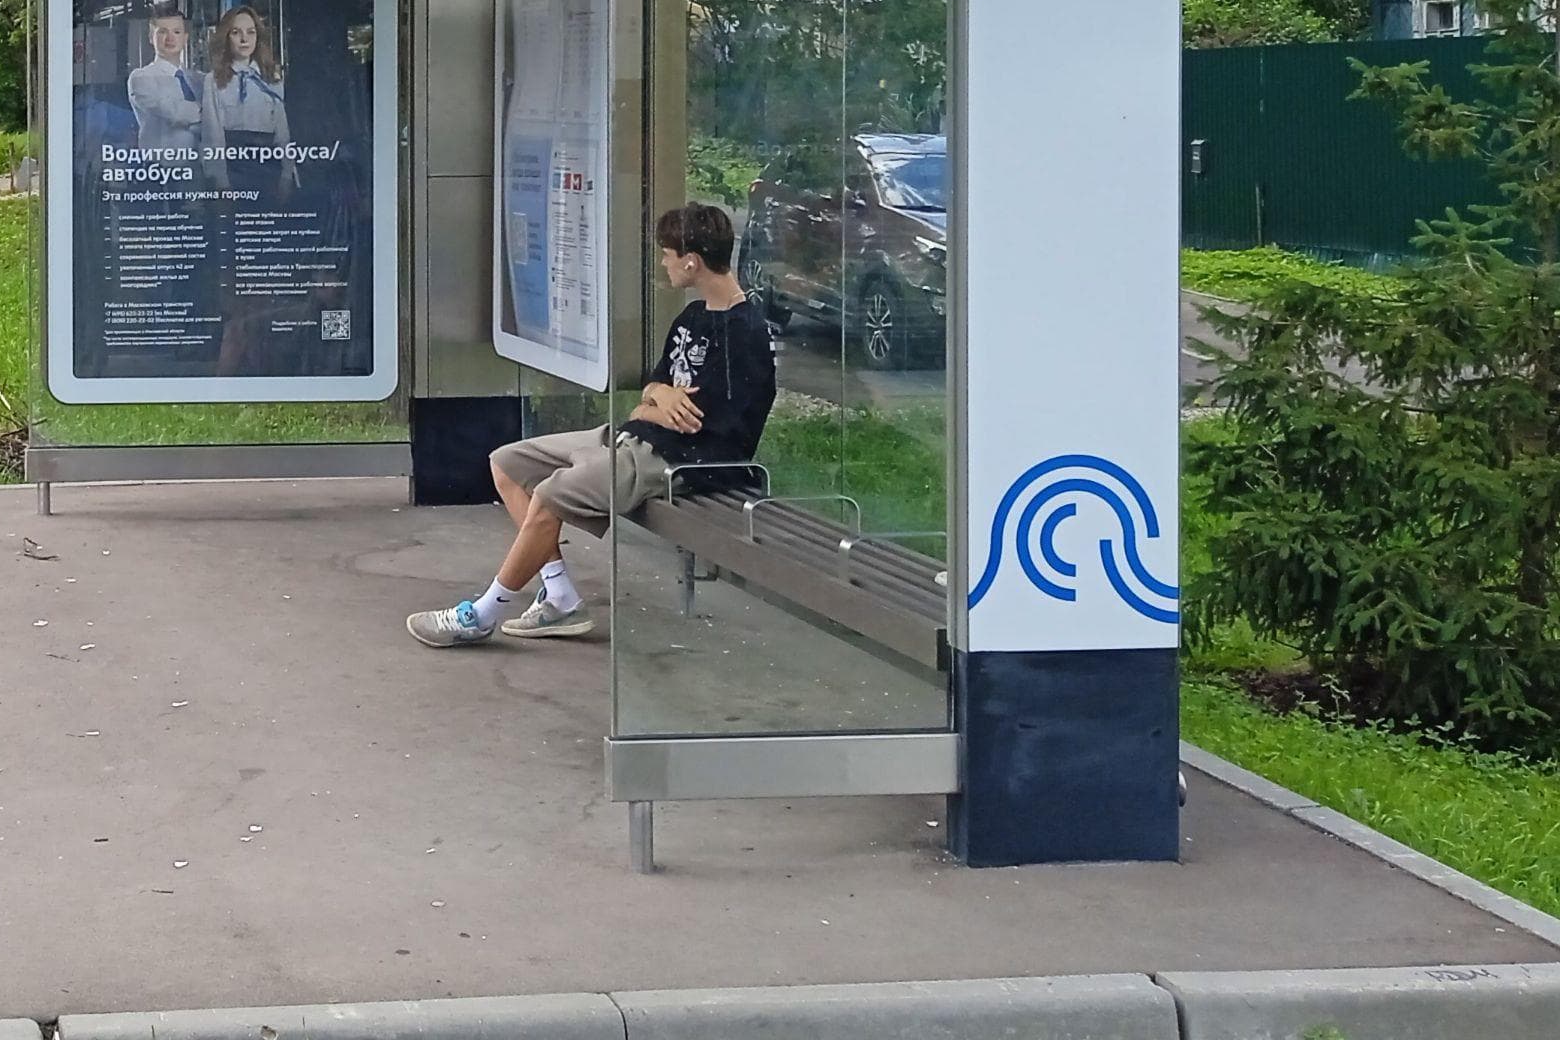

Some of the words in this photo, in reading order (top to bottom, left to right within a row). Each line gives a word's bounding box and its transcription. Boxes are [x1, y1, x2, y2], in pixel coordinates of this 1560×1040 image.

[102, 144, 198, 163] Водитель
[203, 141, 340, 163] электробуса/
[102, 163, 193, 184] автобуса
[102, 190, 121, 201] Эта
[123, 190, 183, 202] профессия
[185, 189, 219, 201] нужна
[221, 189, 259, 201] городу
